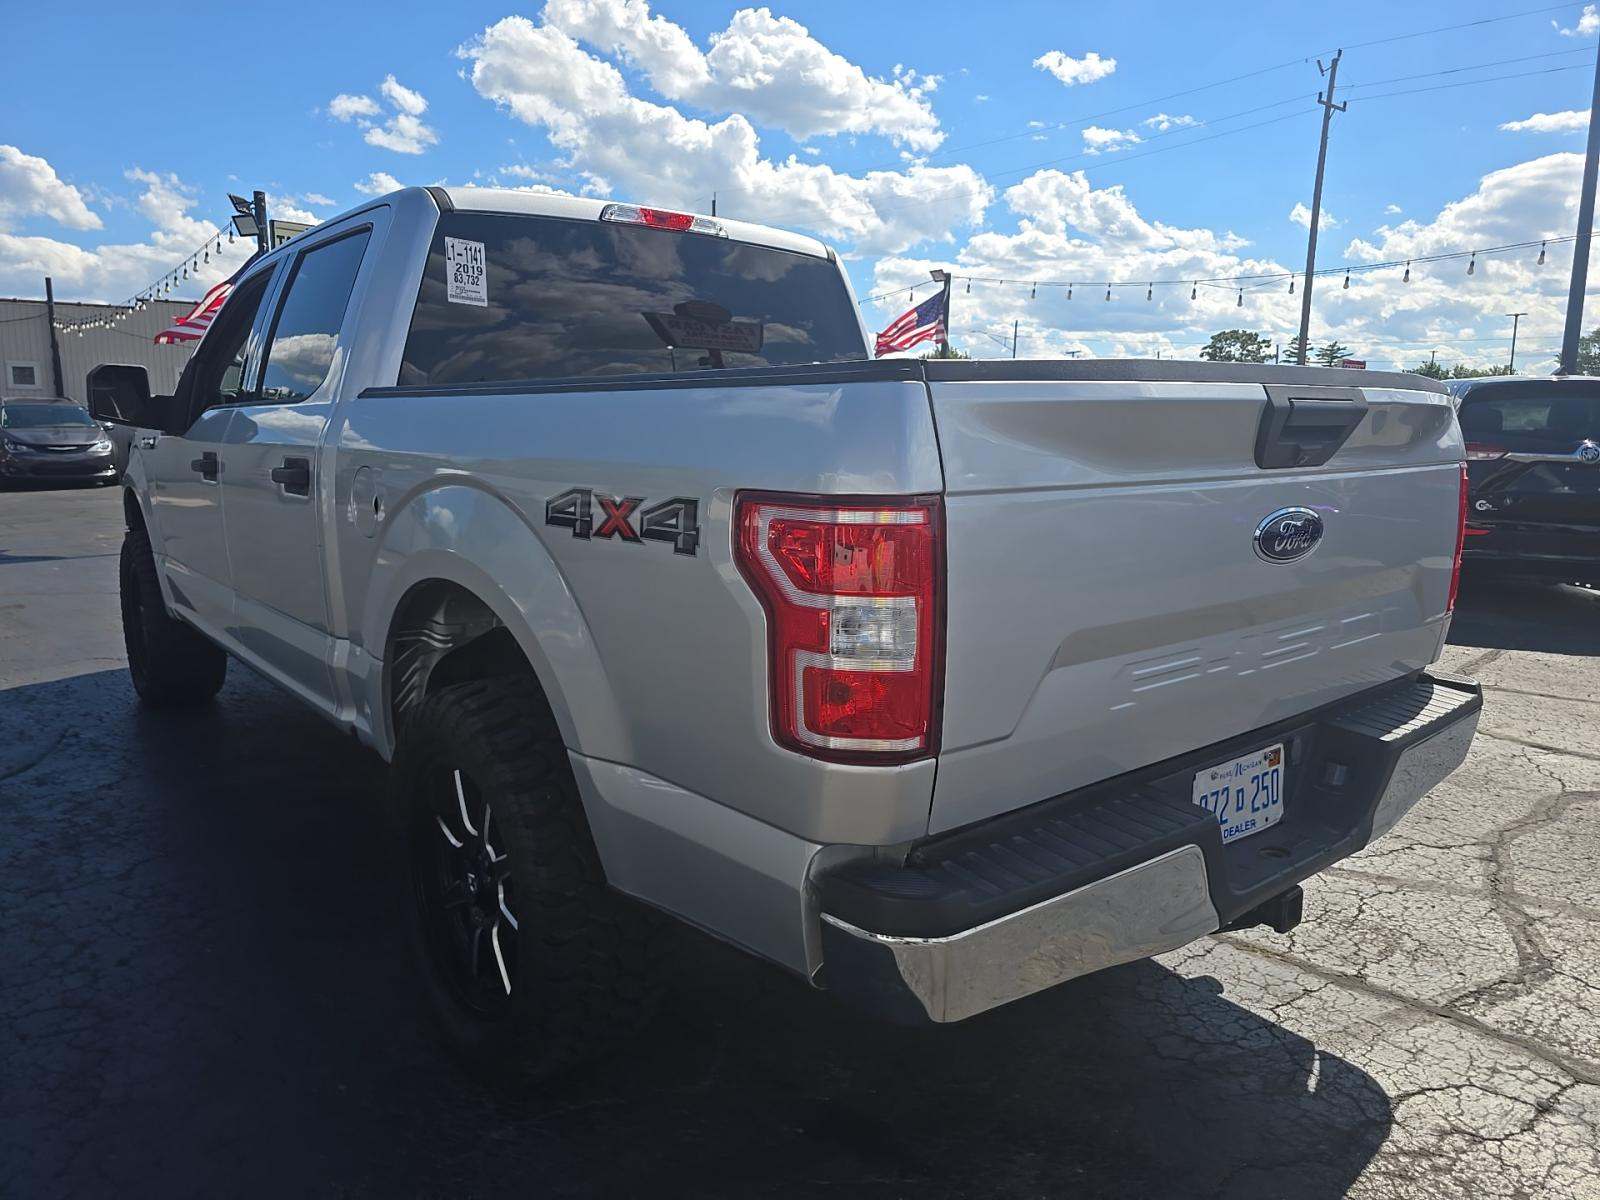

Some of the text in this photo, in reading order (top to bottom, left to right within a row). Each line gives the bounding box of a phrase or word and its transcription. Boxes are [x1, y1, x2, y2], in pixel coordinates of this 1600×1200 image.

[455, 262, 483, 276] 2019
[1275, 520, 1312, 551] Ford
[1251, 768, 1280, 813] 250
[1223, 819, 1257, 839] DEALER
